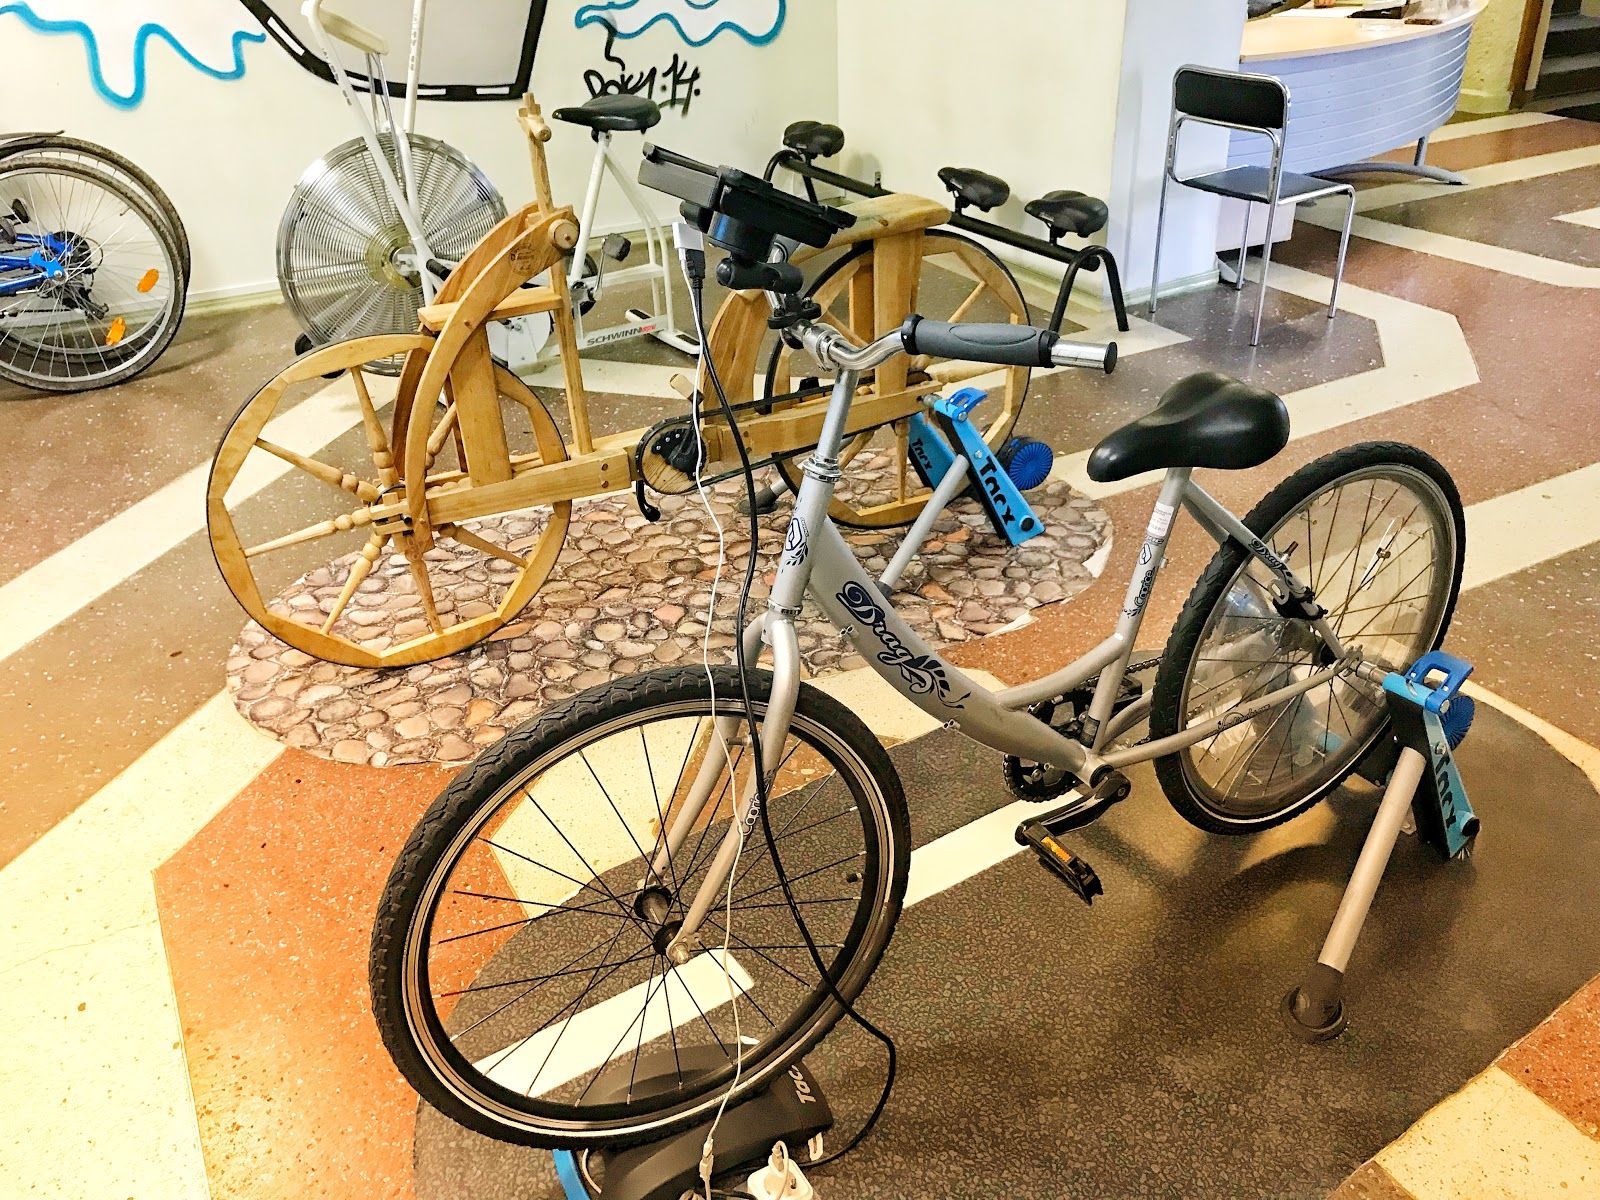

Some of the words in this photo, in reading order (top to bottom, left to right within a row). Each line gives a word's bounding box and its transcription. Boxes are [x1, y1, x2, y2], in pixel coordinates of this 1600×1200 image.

[587, 328, 641, 345] SCHWINN
[979, 455, 1015, 526] Tacx
[738, 792, 762, 836] Capri
[788, 1065, 816, 1104] Tac
